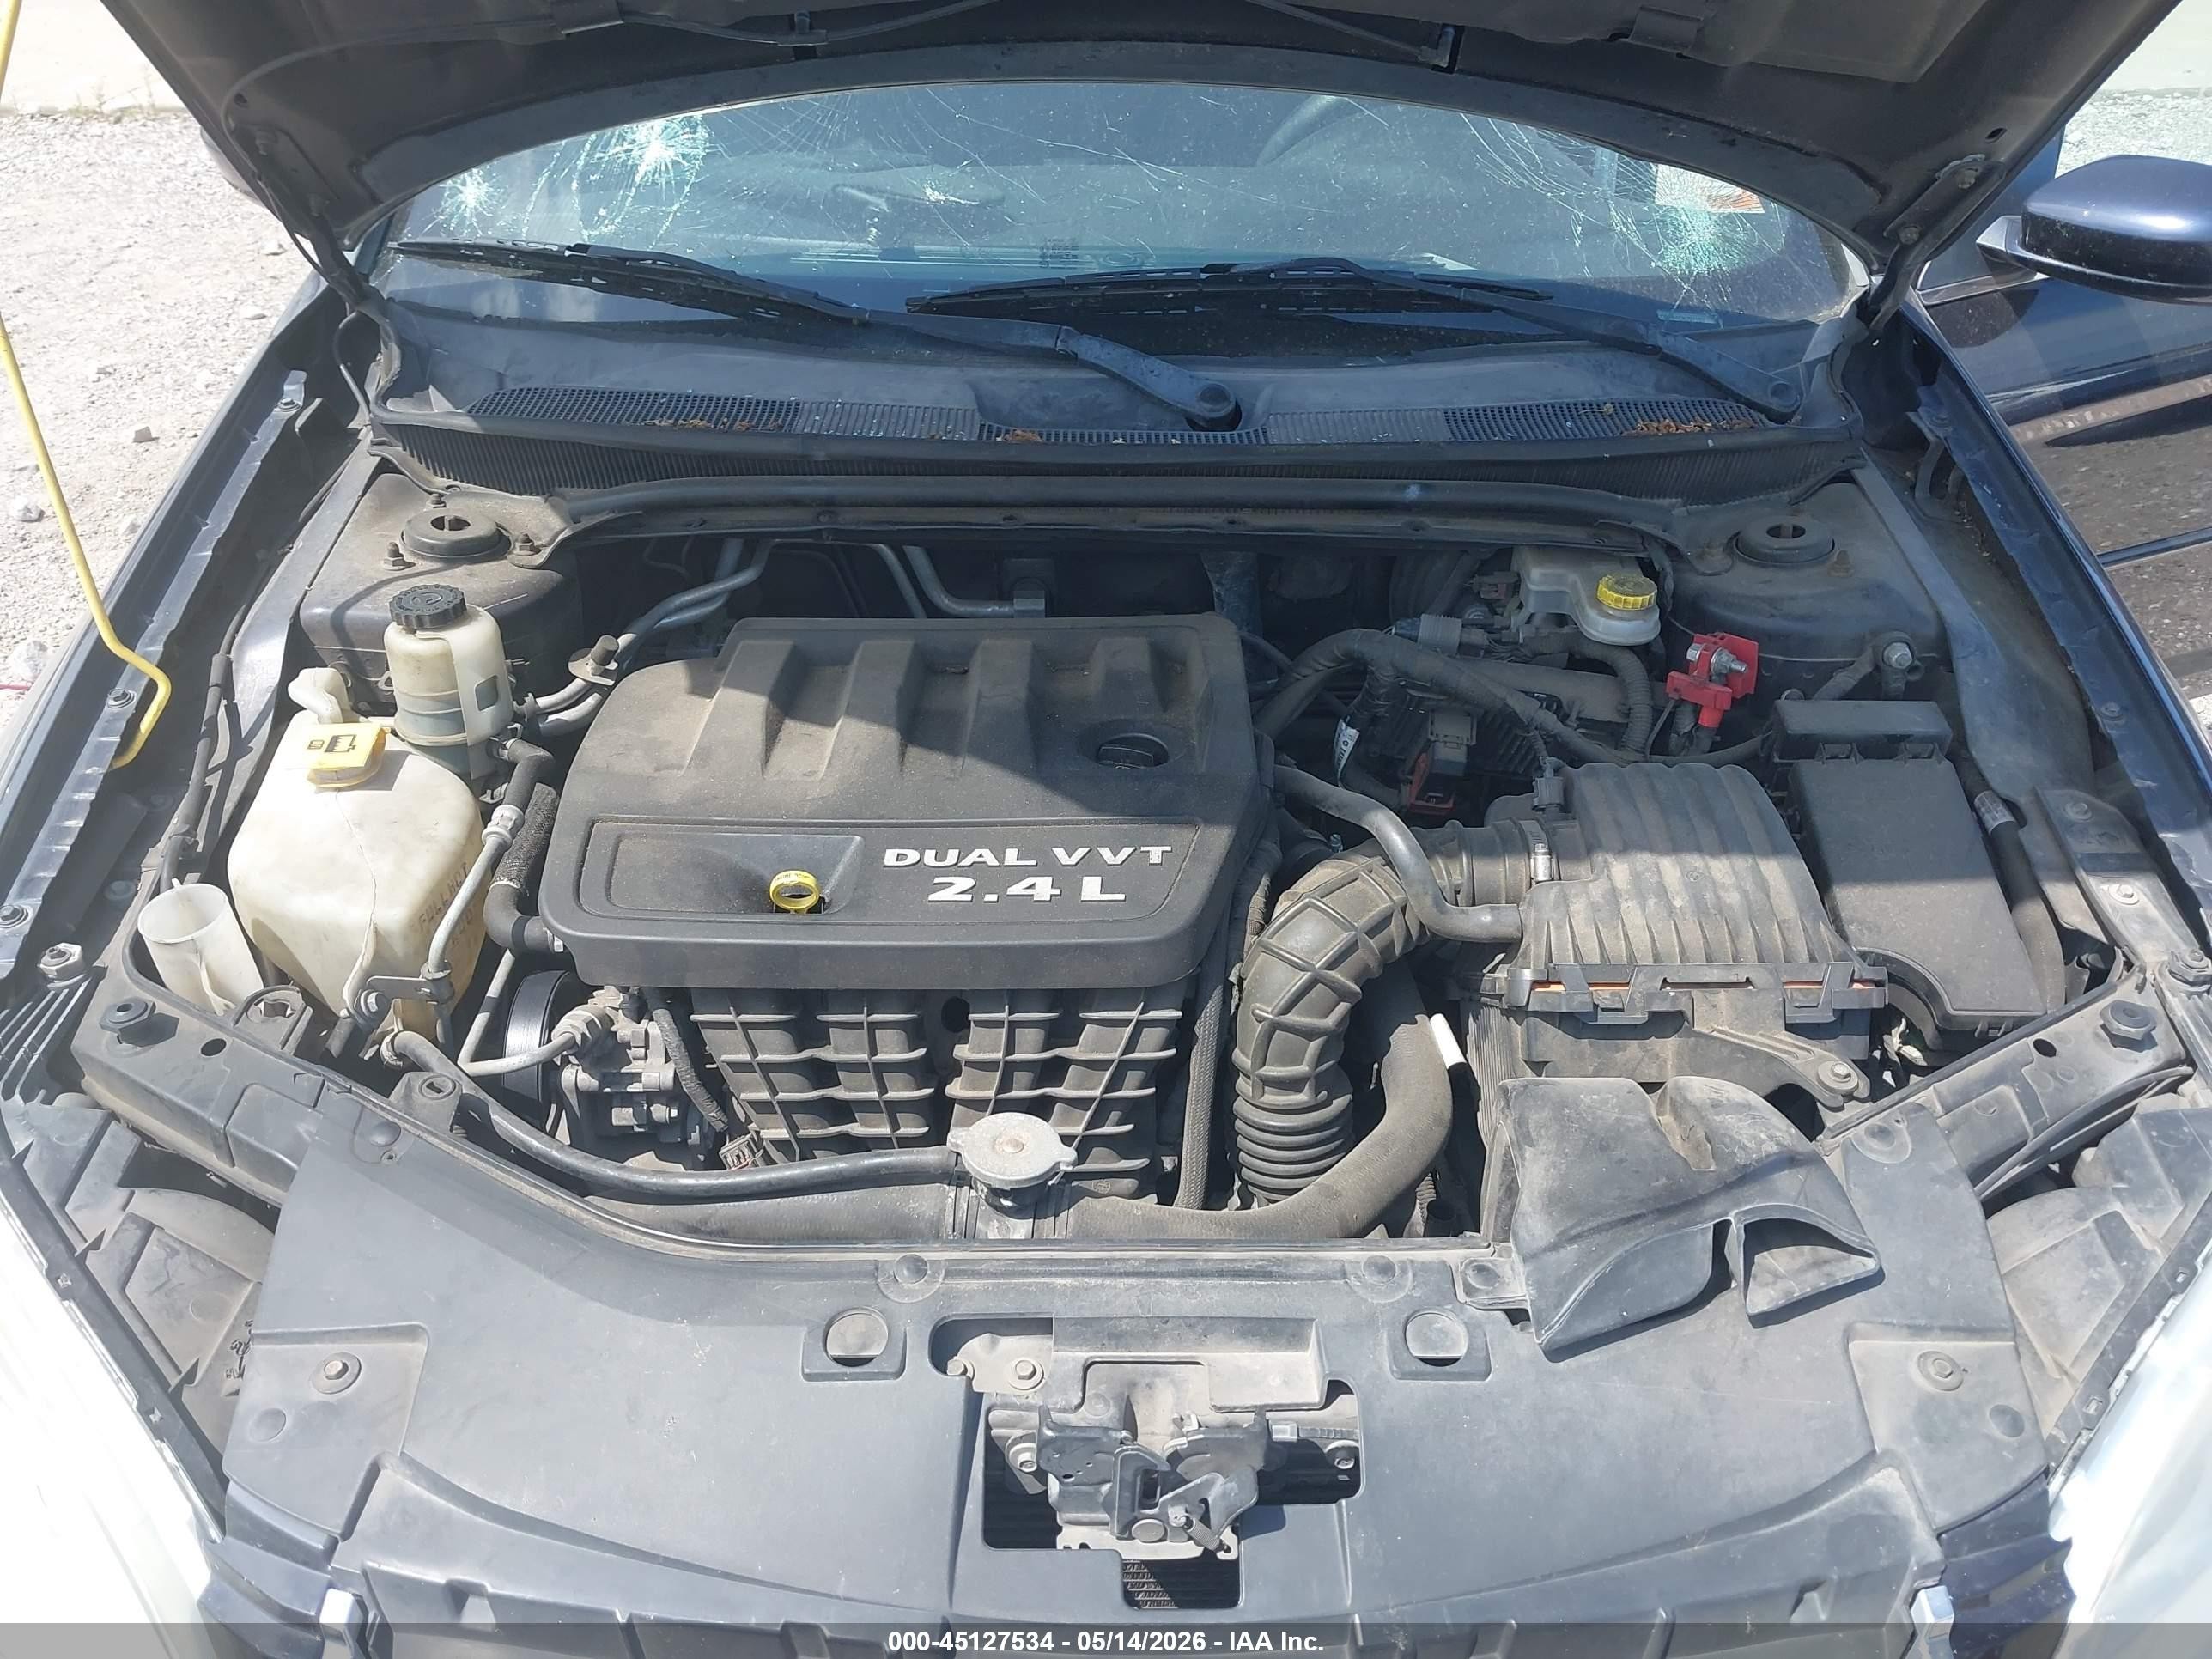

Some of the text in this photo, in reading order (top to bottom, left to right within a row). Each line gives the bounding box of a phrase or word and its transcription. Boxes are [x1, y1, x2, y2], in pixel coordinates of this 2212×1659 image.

[884, 847, 1171, 866] DUAL VVT
[928, 877, 1125, 901] 2.4 L
